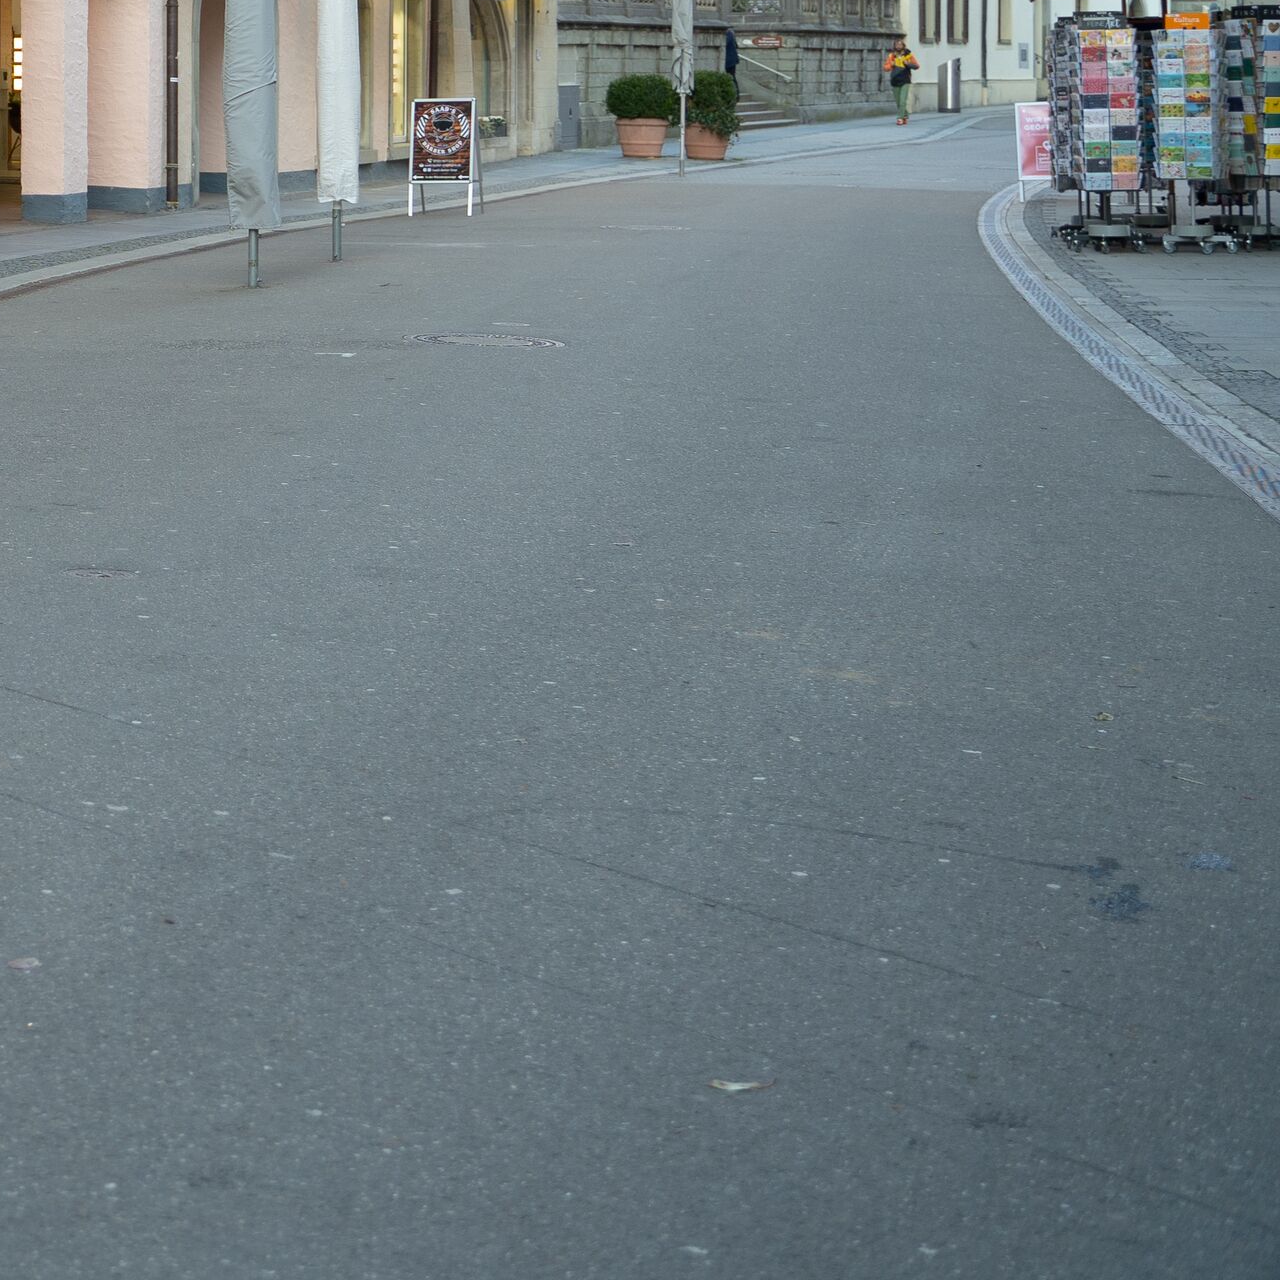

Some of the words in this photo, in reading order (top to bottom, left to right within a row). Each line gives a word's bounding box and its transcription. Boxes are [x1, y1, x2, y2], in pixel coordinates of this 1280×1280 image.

[430, 106, 456, 115] SAAD'S
[422, 140, 446, 154] BARBER
[447, 140, 463, 154] SHOP
